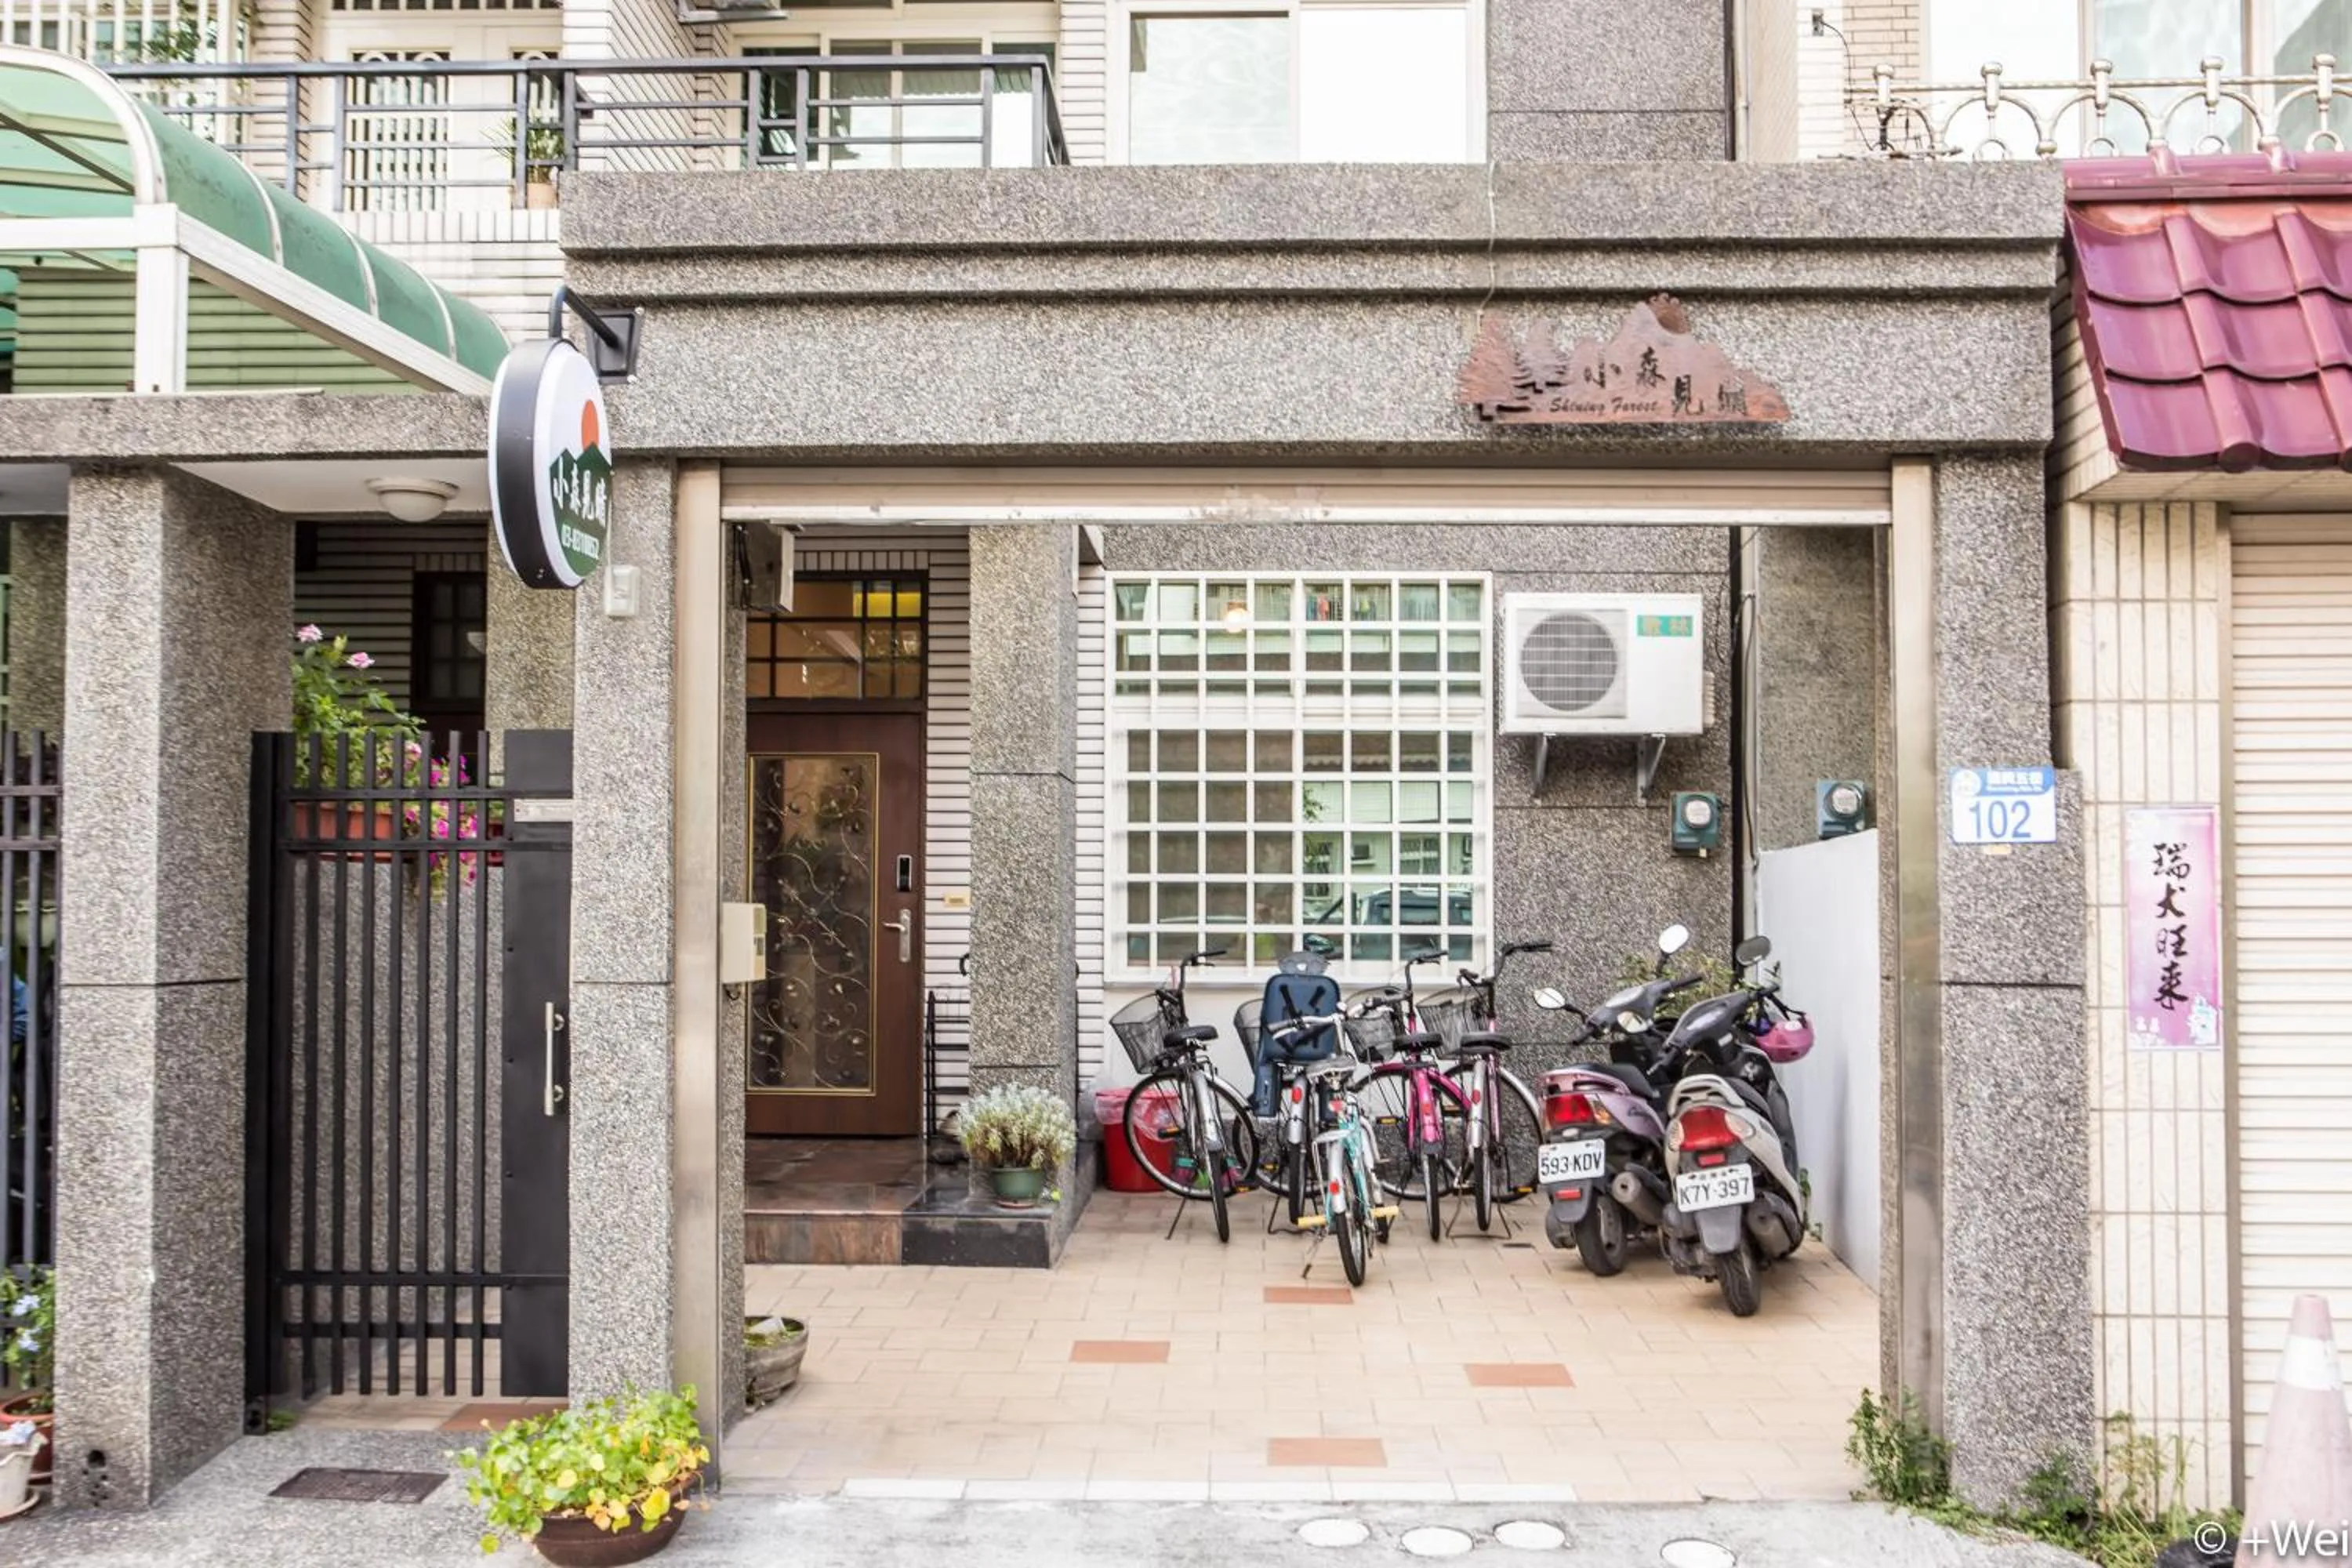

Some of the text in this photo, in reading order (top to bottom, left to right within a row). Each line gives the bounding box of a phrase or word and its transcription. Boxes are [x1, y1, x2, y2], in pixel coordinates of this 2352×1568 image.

[1549, 395, 1660, 416] Shining Forest
[1969, 800, 2031, 839] 102
[1541, 1150, 1602, 1177] 593-KDV
[1679, 1176, 1750, 1205] K7Y-397
